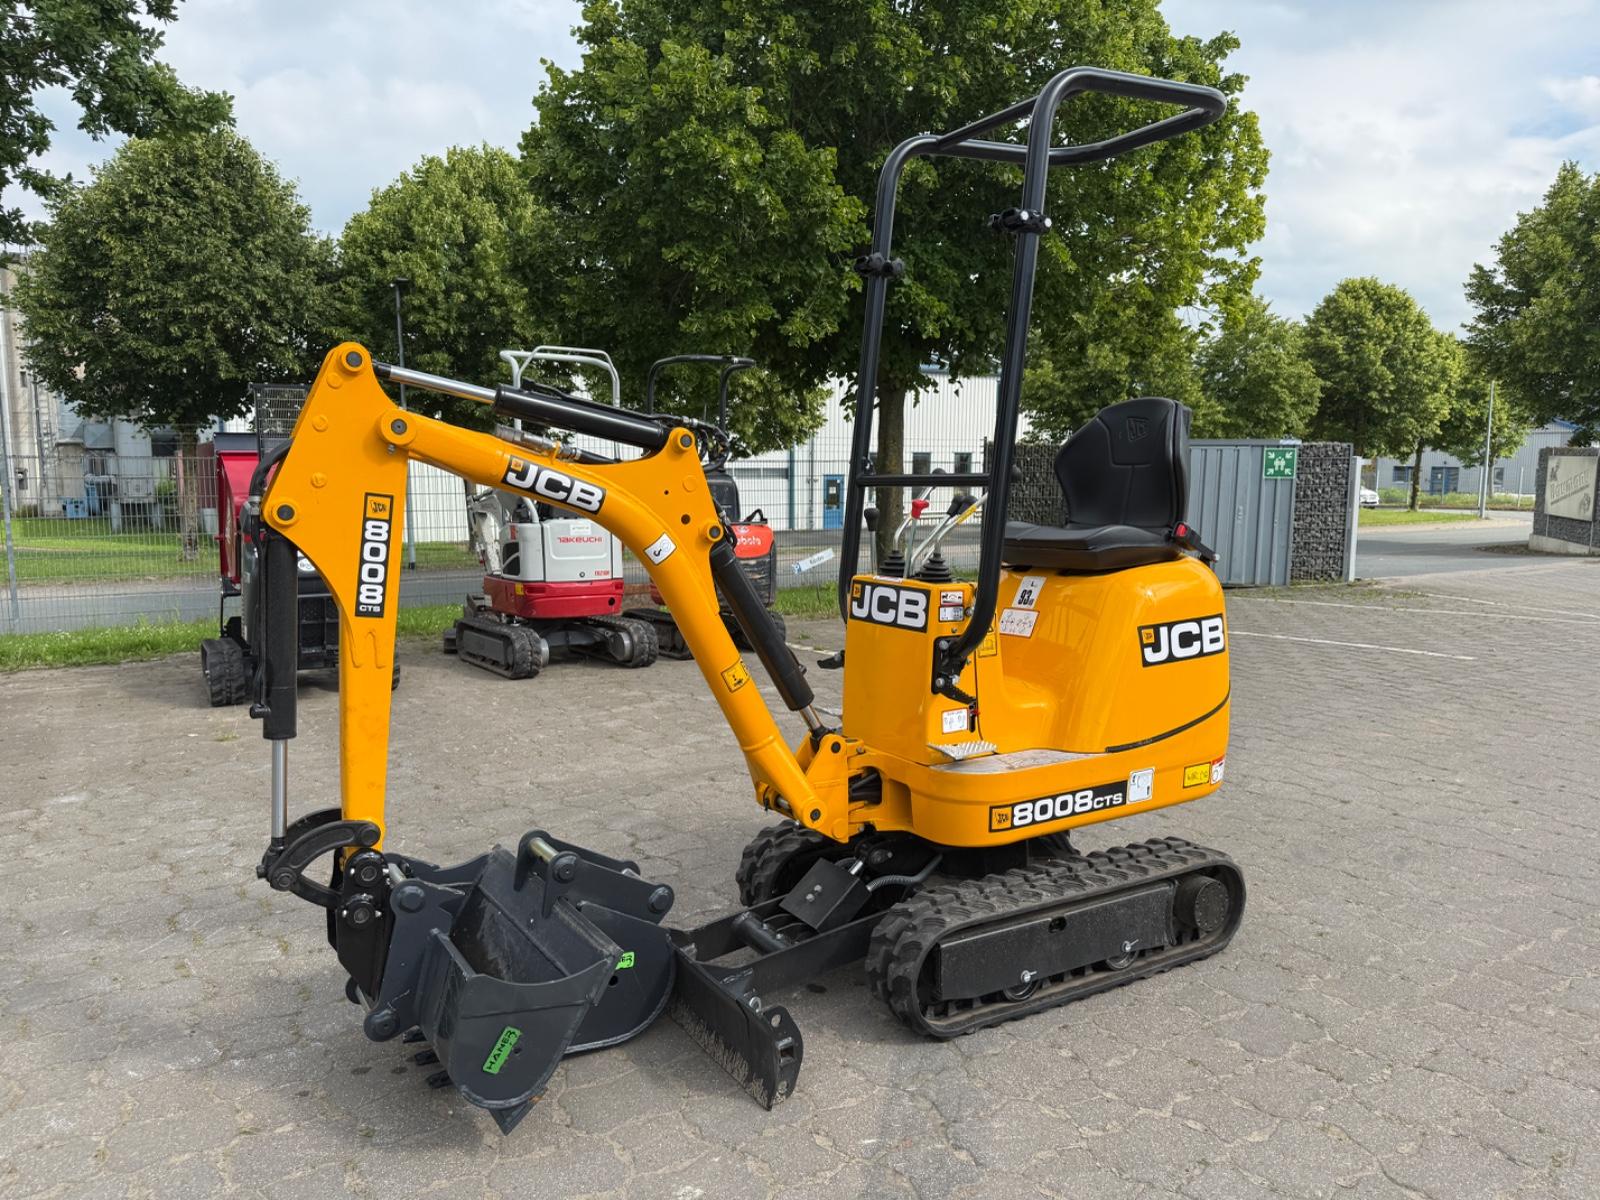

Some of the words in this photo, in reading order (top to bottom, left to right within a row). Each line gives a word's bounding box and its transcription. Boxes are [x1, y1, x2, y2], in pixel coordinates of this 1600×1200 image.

[507, 464, 603, 512] JCB
[557, 536, 603, 544] TAKEUCHI
[734, 535, 762, 545] ubota
[359, 520, 389, 605] 8008
[359, 604, 381, 613] CTS
[852, 584, 928, 628] JCB
[1143, 616, 1225, 663] JCB
